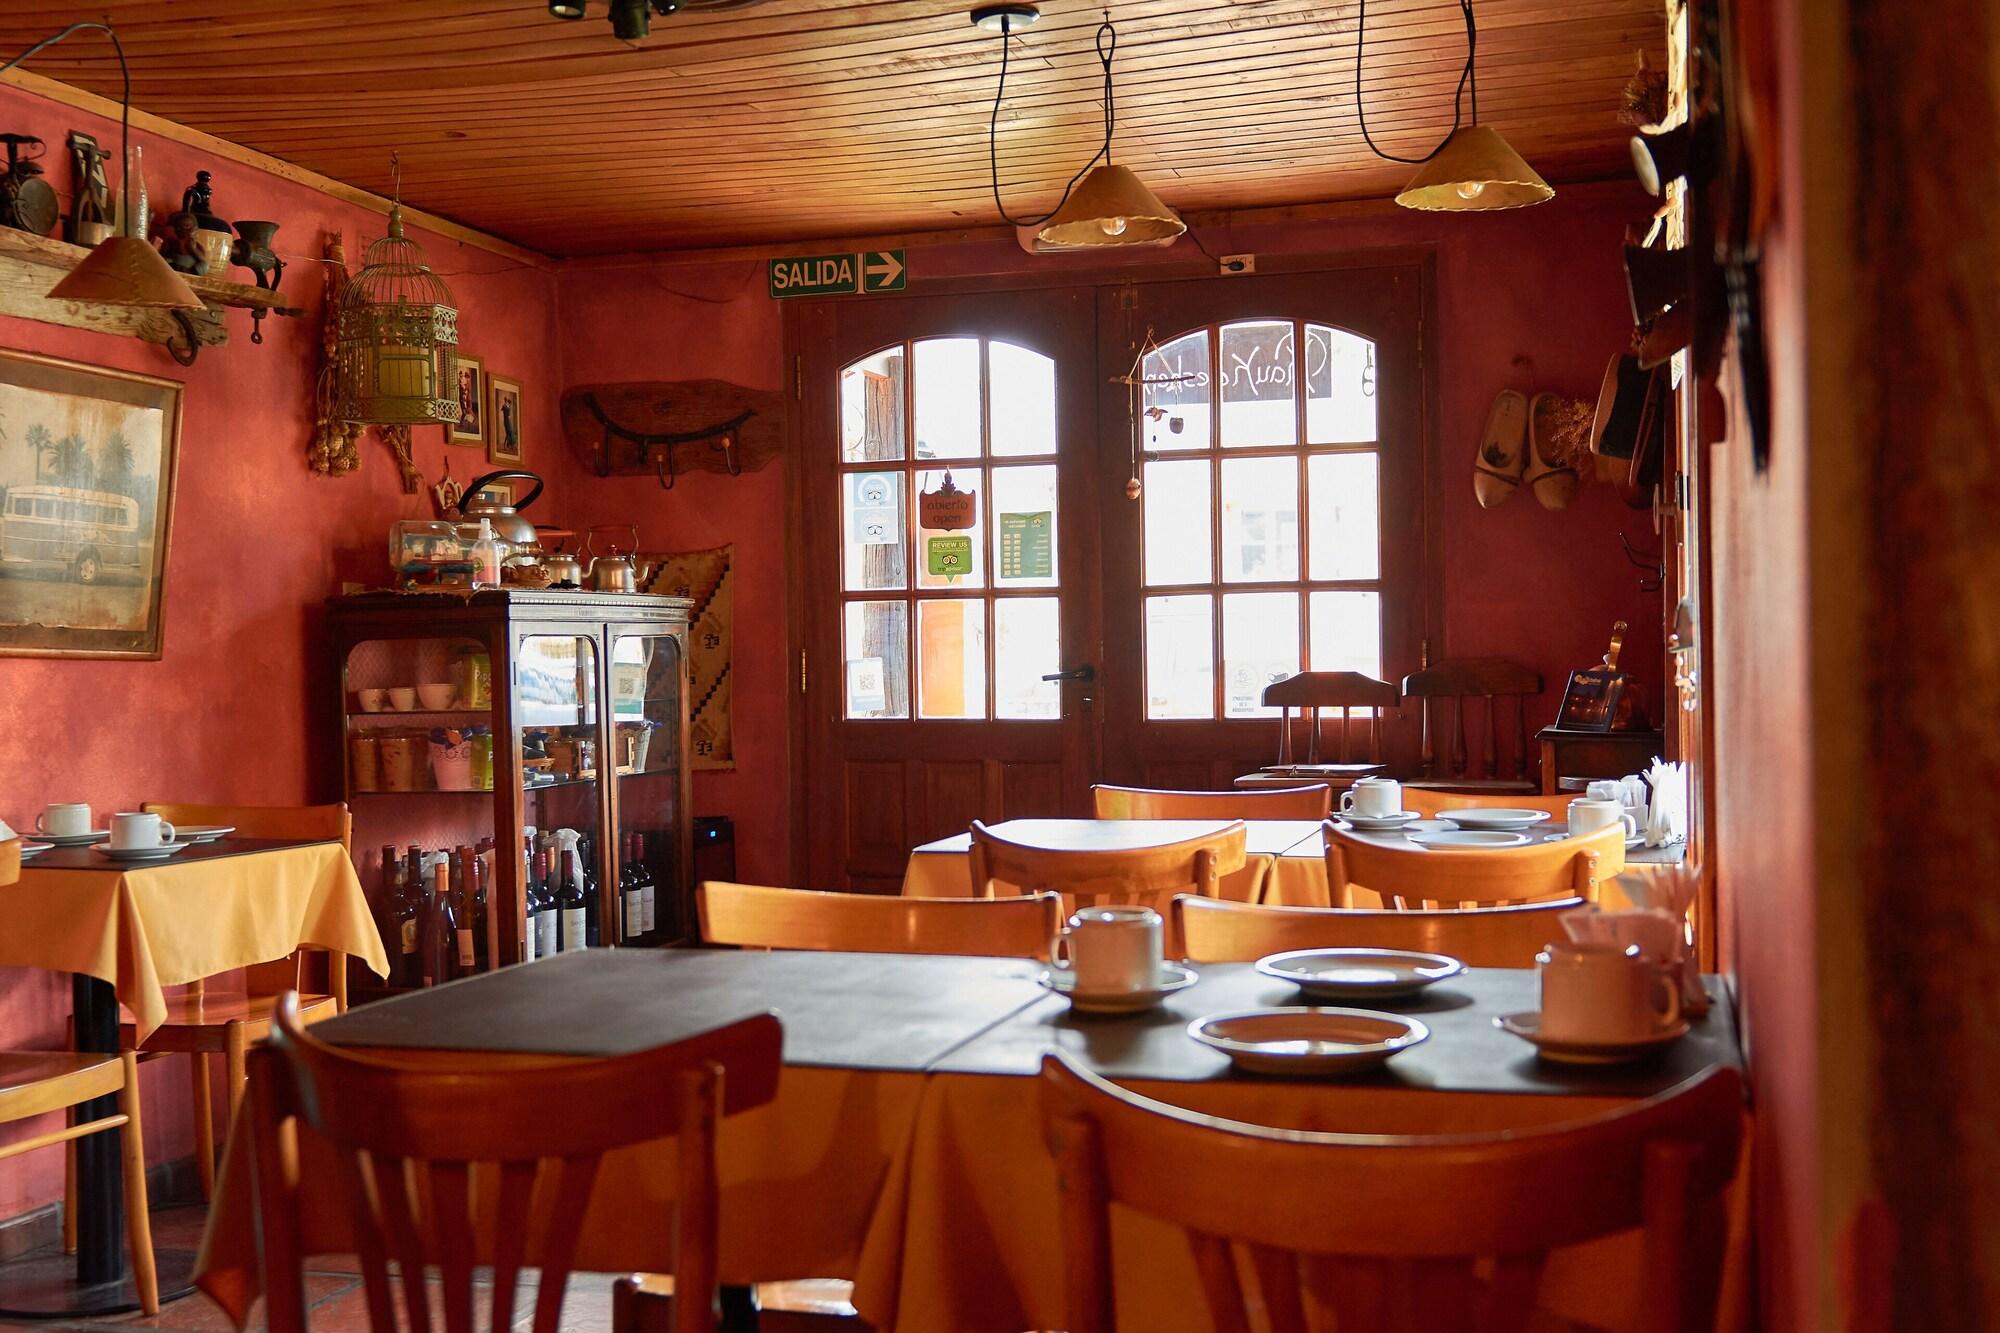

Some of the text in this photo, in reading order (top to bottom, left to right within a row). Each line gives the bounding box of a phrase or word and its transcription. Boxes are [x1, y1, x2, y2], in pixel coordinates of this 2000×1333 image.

[774, 259, 853, 289] SALIDA
[927, 499, 968, 511] abierto
[933, 515, 961, 524] open
